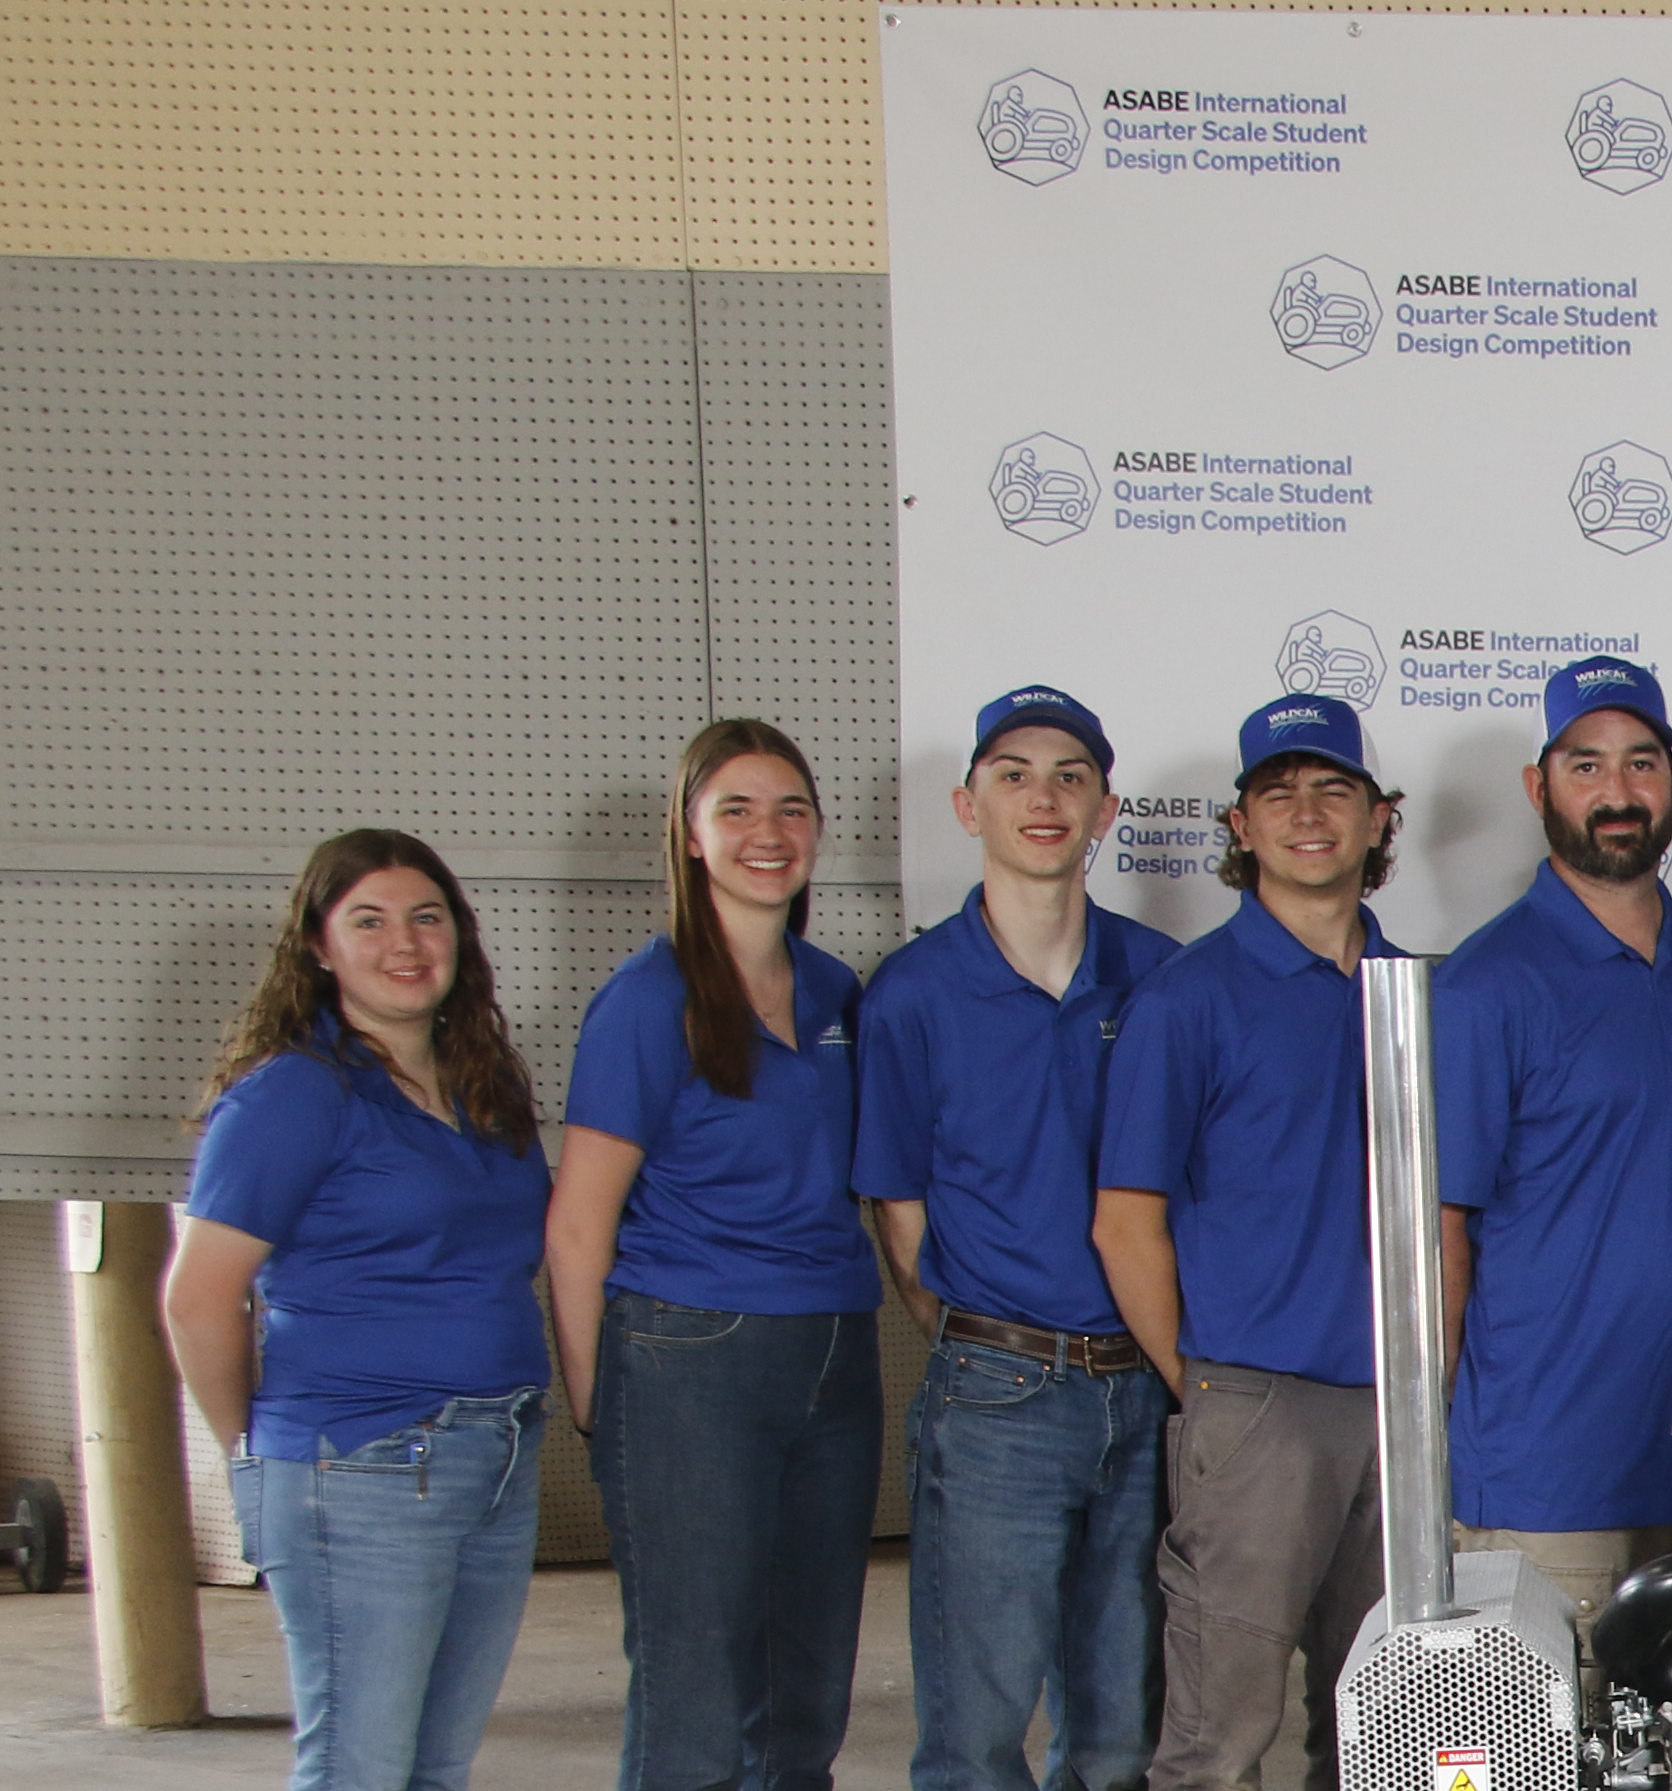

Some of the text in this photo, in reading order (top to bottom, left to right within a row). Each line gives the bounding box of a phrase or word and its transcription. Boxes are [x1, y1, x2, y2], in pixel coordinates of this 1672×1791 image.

[1103, 89, 1346, 114] ASABE International
[1104, 118, 1367, 143] Quarter Scale Student
[1106, 148, 1340, 175] Design Competition
[1396, 275, 1636, 298] ASABE International
[1396, 304, 1657, 327] Quarter Scale Student
[1398, 333, 1630, 359] Design Competition
[1113, 452, 1351, 475] ASABE International
[1114, 480, 1372, 504] Quarter Scale Student
[1116, 509, 1345, 535] Design Competition
[1401, 630, 1639, 652] ASABE International
[1400, 658, 1491, 681] Quarter
[1448, 1752, 1485, 1763] DANGER
